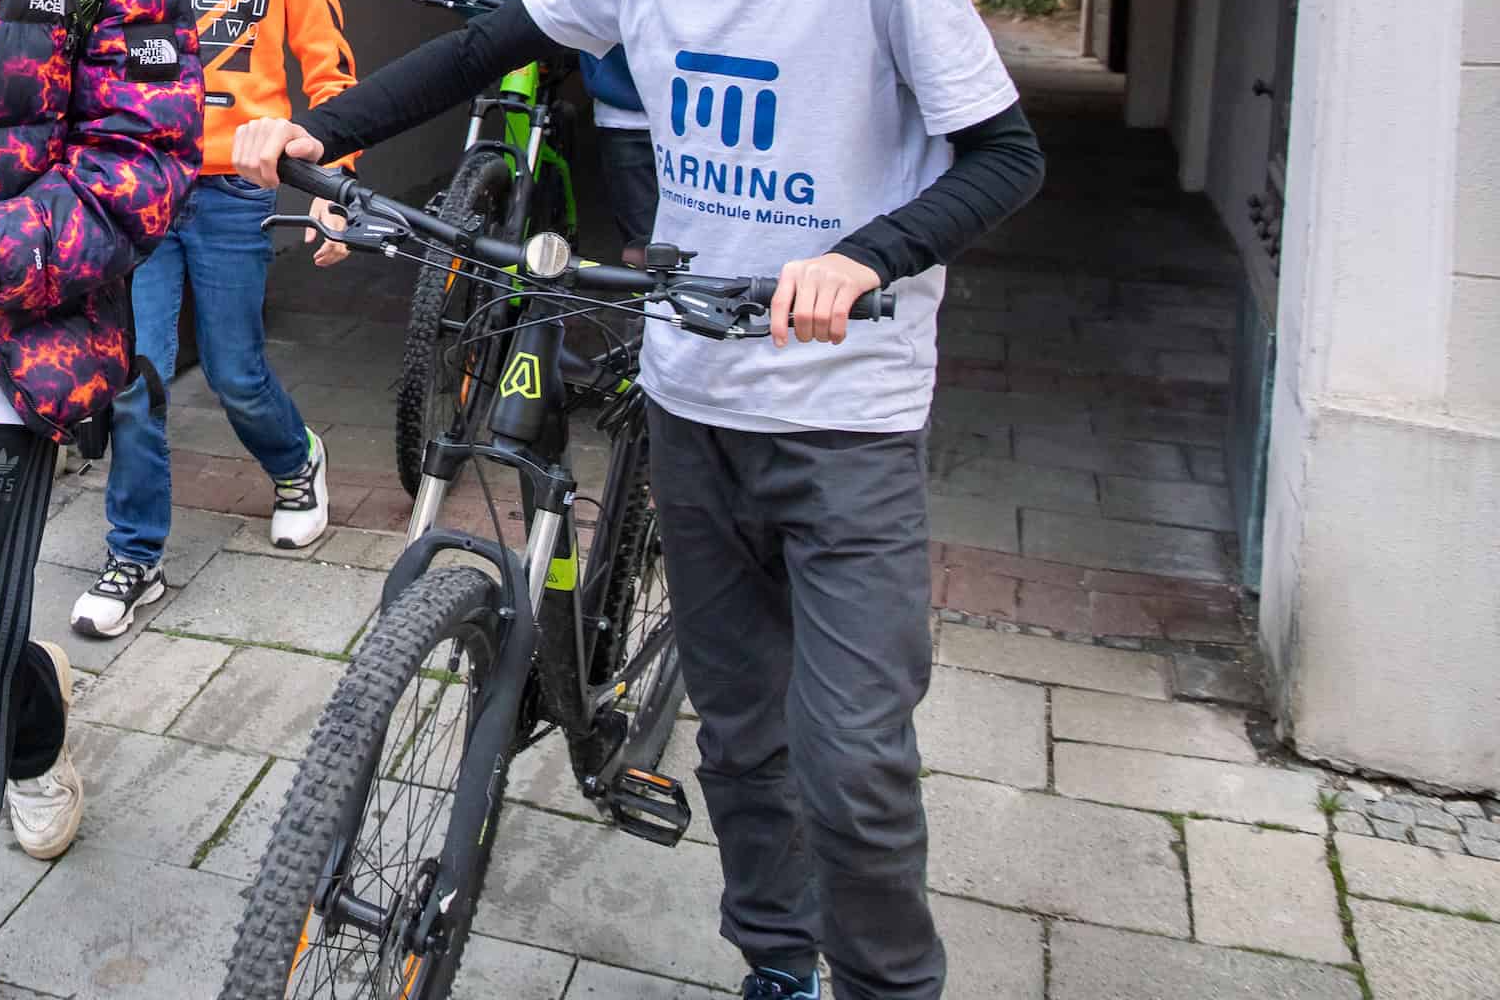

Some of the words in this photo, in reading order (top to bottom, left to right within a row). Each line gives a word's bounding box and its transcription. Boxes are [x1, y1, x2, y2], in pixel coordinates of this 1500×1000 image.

[143, 39, 163, 48] THE
[130, 47, 163, 57] NORTH
[140, 55, 164, 64] FACE
[755, 209, 842, 230] München
